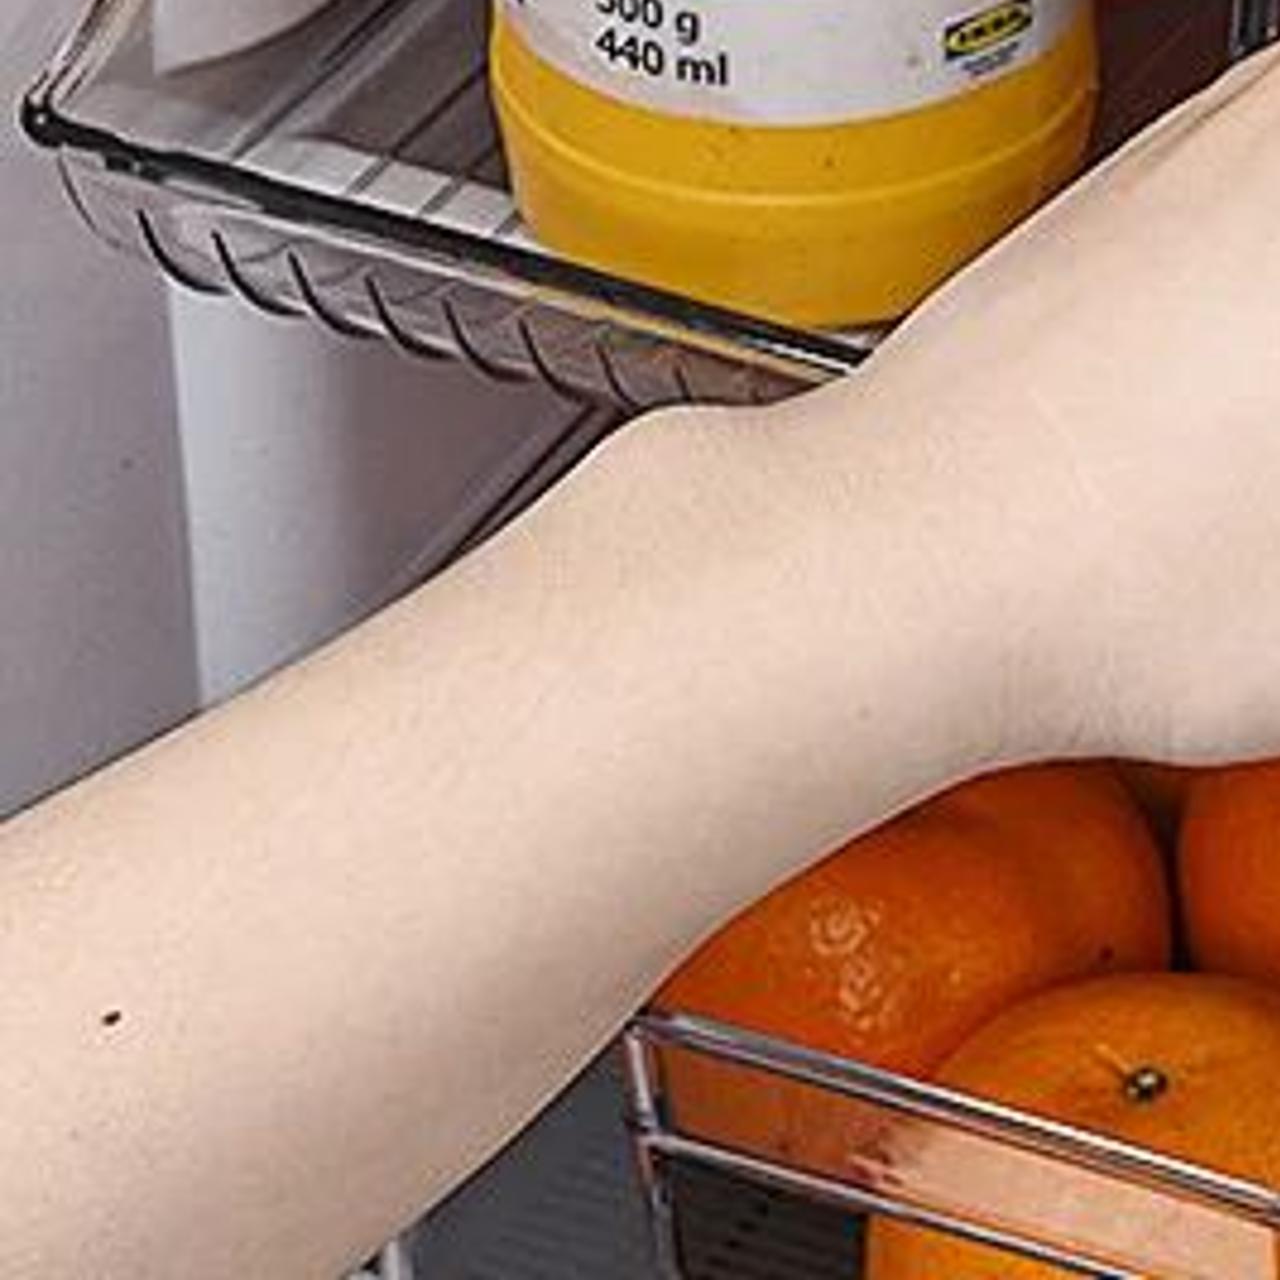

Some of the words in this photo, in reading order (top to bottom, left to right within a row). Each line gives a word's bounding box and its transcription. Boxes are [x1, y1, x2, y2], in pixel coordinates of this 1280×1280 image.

[676, 7, 701, 45] g
[595, 29, 664, 78] 440
[676, 52, 730, 88] ml
